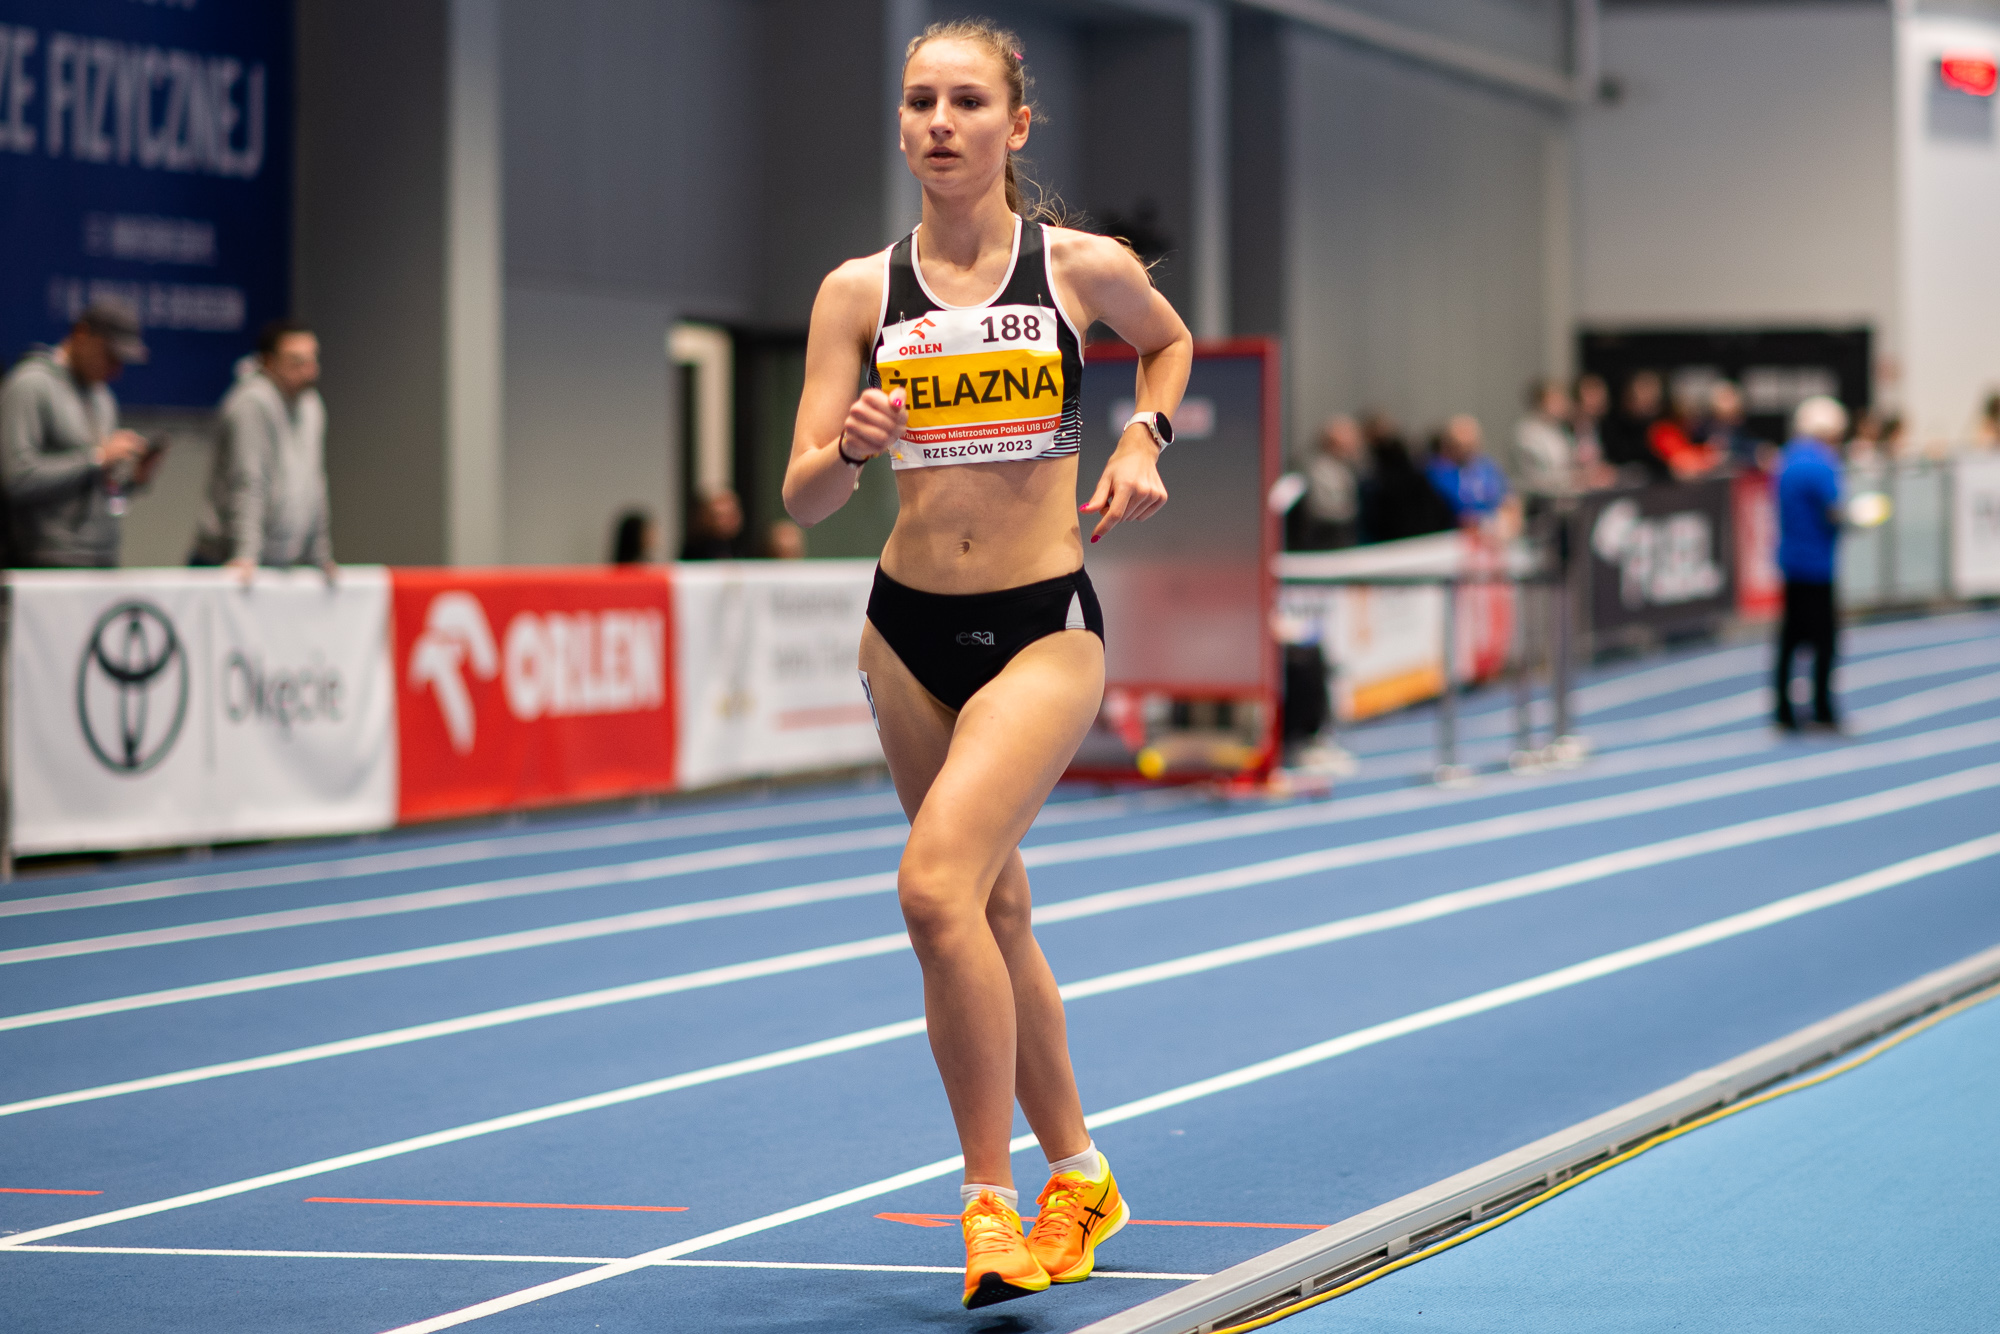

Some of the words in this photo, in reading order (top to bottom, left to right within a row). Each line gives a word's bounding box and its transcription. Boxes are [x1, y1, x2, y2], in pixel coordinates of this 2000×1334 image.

[980, 314, 1041, 343] 188
[899, 343, 942, 356] ORLEN
[916, 430, 946, 442] Halowe
[948, 428, 999, 439] Mistrzostwa
[1001, 424, 1025, 434] Polski
[1026, 422, 1041, 432] U18
[1042, 420, 1056, 430] U20
[923, 441, 994, 459] RZESZÓW
[998, 439, 1033, 453] 2023
[502, 609, 666, 721] ORLEN
